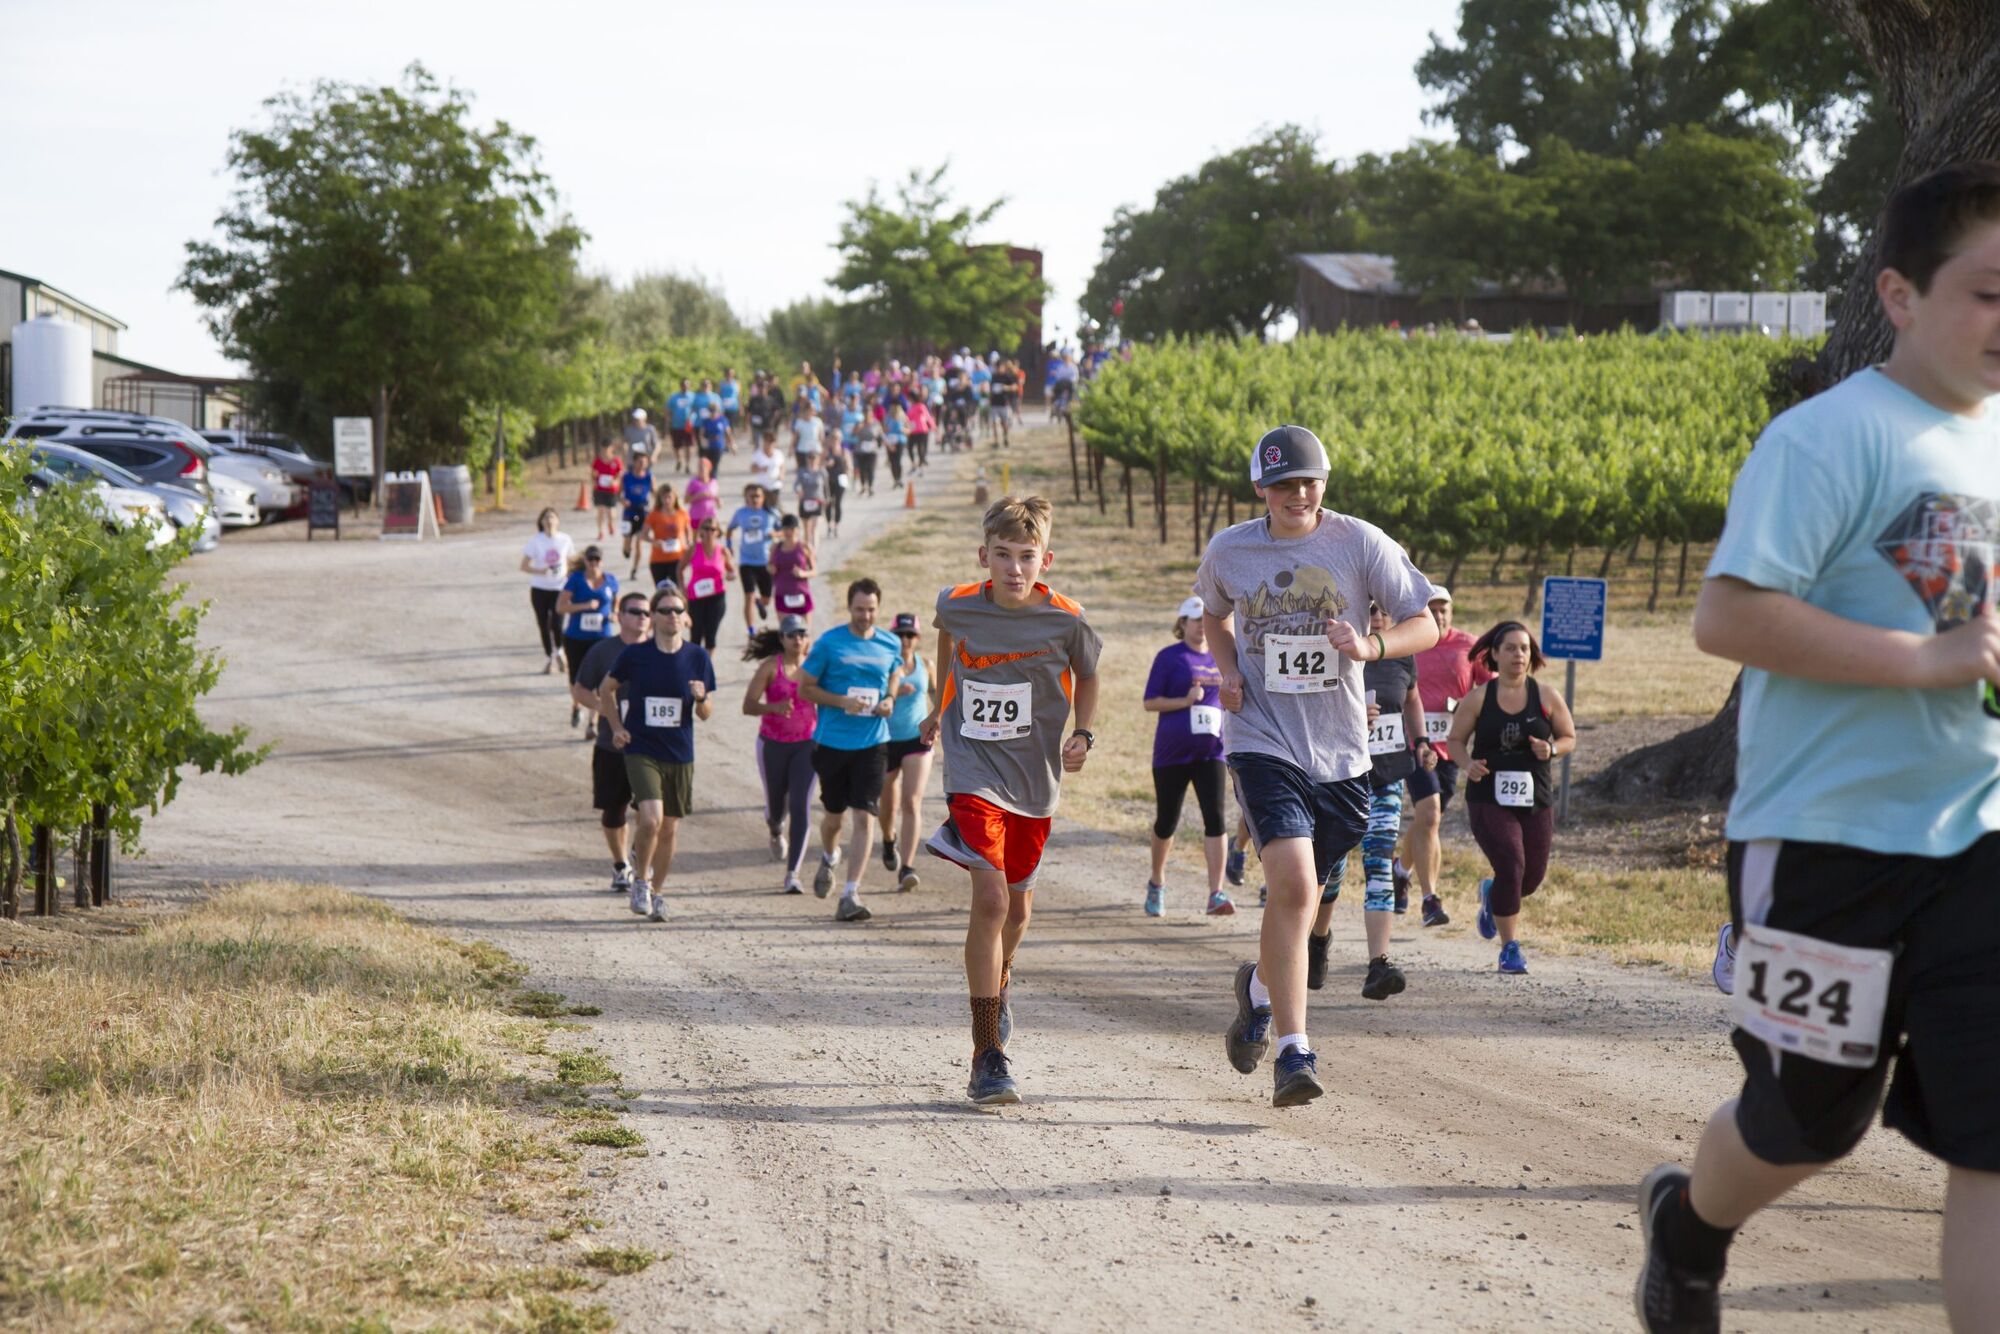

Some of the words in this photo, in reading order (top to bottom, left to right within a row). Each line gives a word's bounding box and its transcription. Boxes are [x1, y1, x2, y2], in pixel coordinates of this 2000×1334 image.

[1278, 651, 1325, 674] 142
[652, 705, 675, 717] 185
[972, 698, 1018, 722] 279
[1501, 781, 1527, 795] 292
[1747, 960, 1852, 1027] 124
